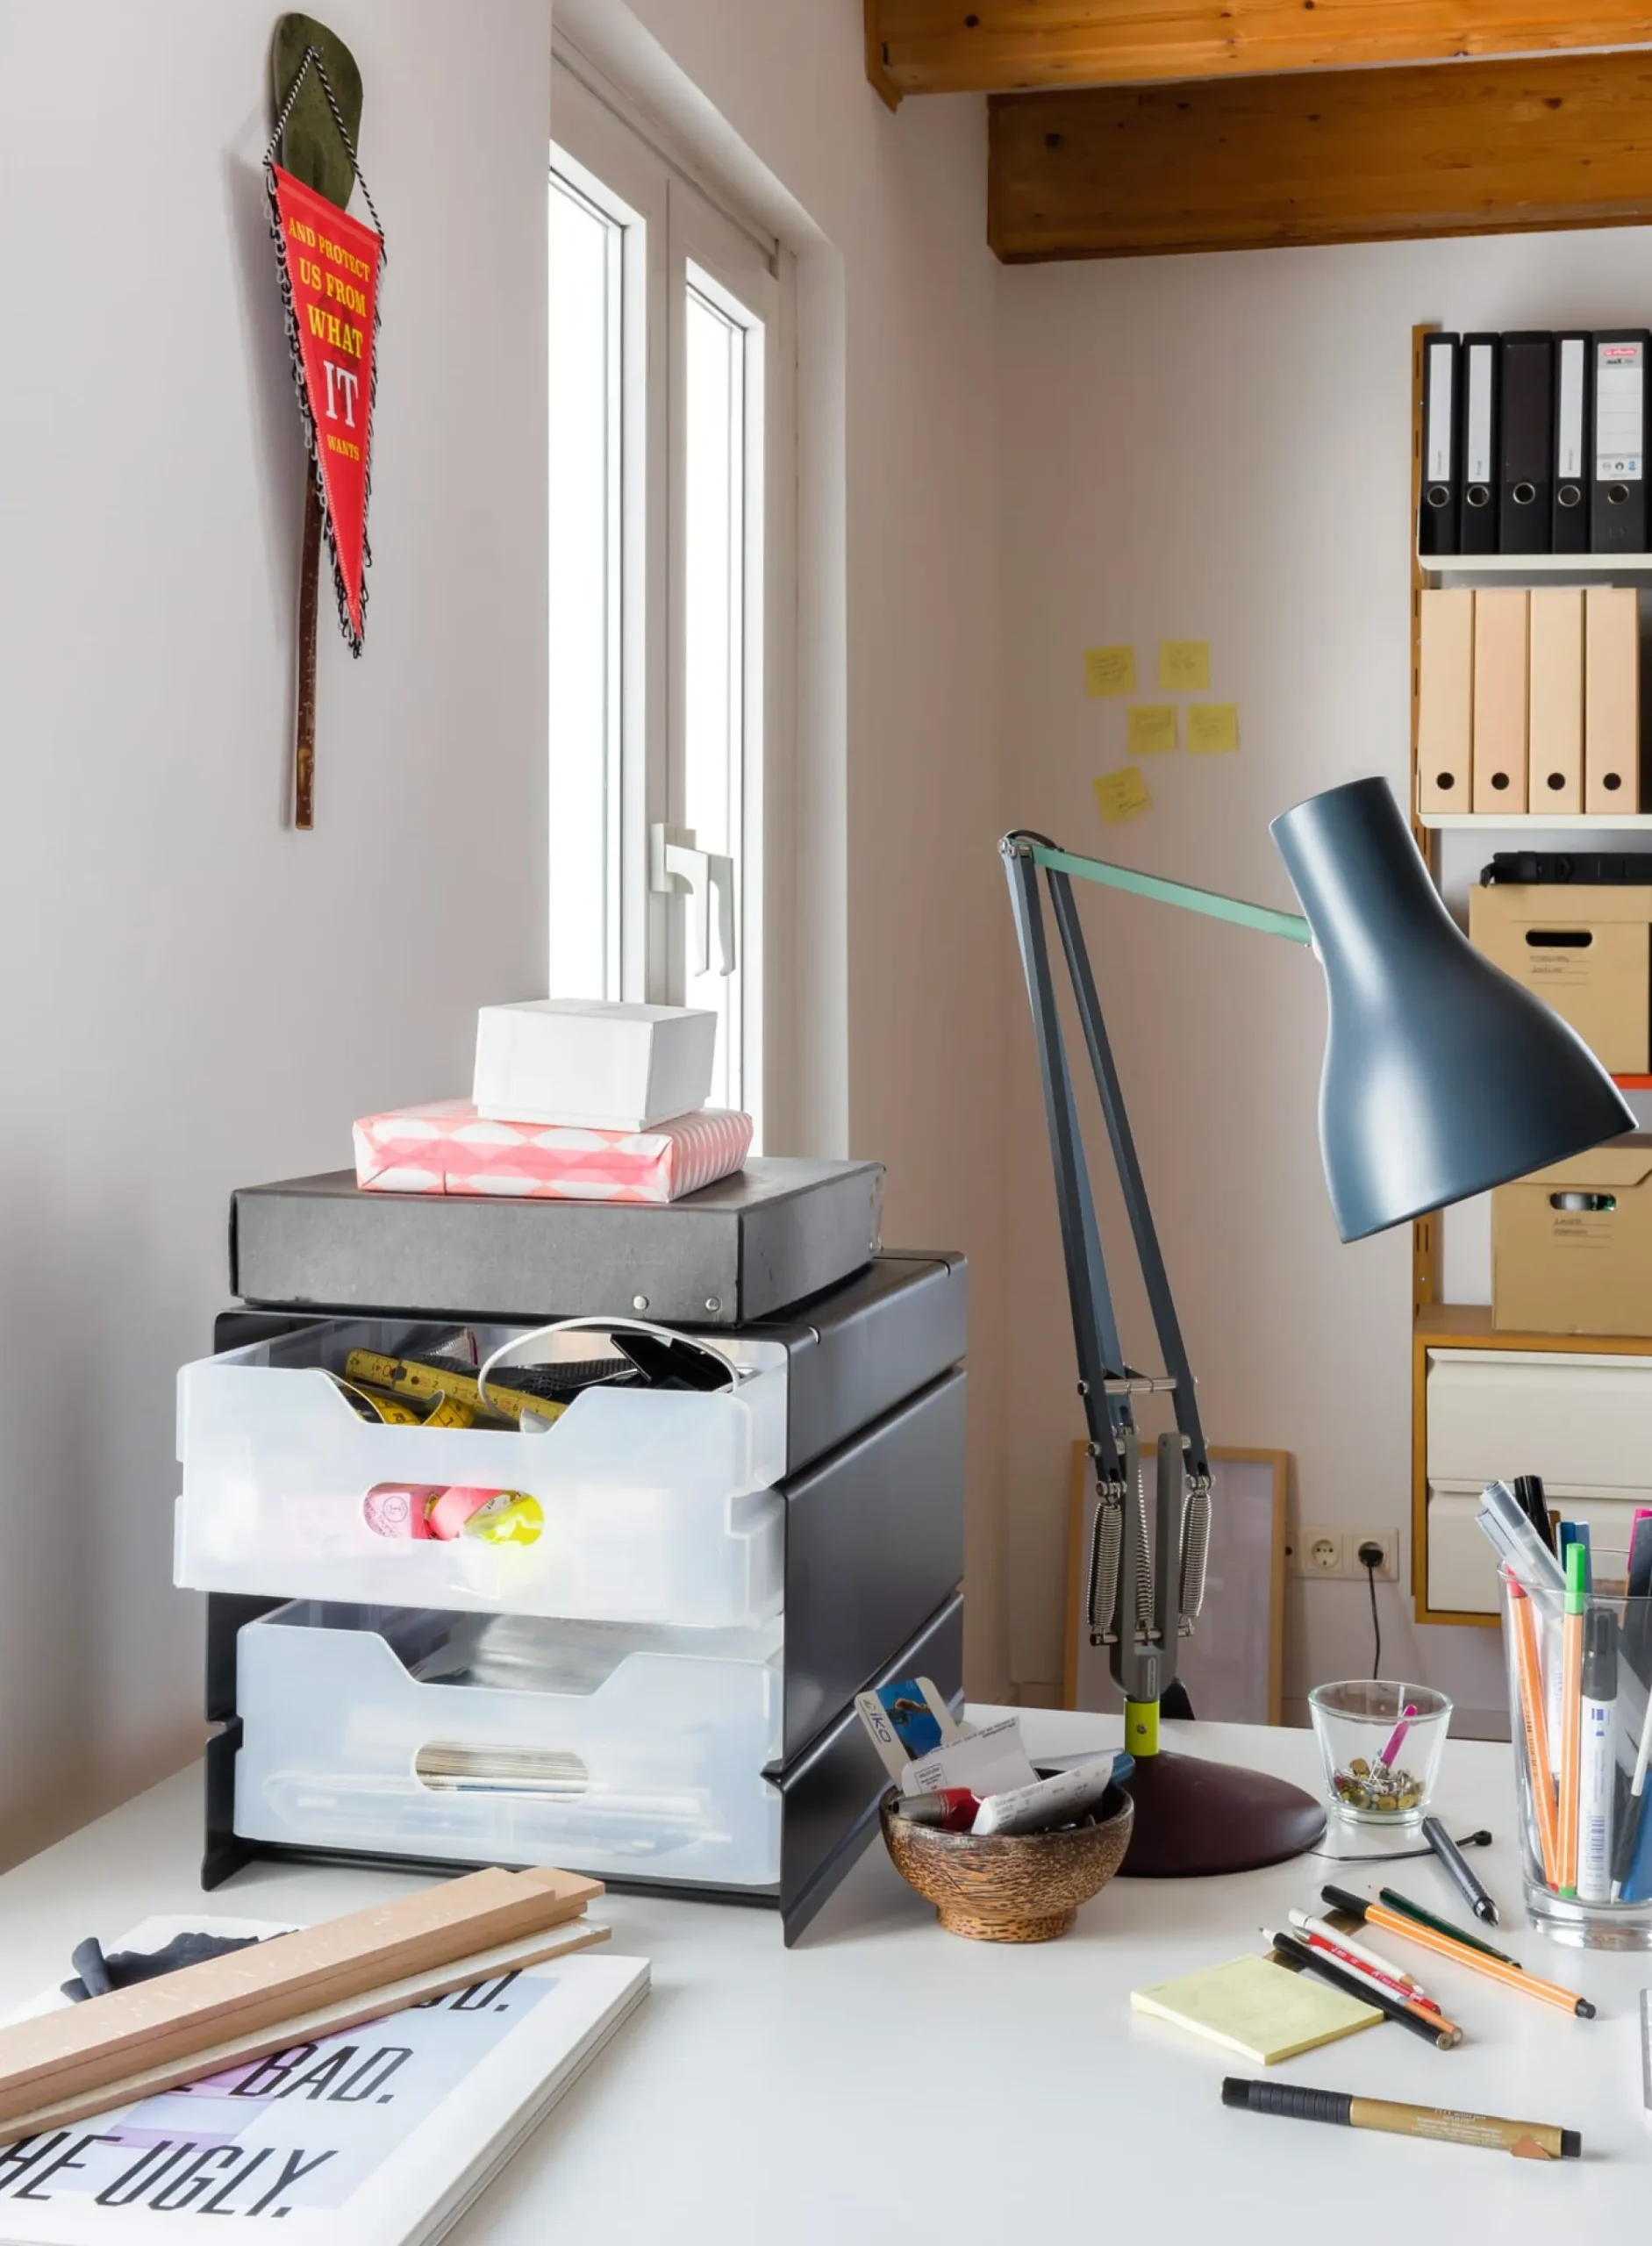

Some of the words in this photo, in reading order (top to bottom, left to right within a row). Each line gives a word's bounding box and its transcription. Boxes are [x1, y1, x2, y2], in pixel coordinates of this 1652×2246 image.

[289, 217, 316, 247] AND
[318, 233, 370, 282] PROTECT
[298, 257, 321, 291] US
[325, 271, 367, 318] FROM
[306, 304, 363, 359] WHAT
[323, 361, 359, 428] IT
[327, 434, 361, 461] WANTS
[228, 2043, 413, 2104] BAD.
[94, 2141, 340, 2218] UGLY.
